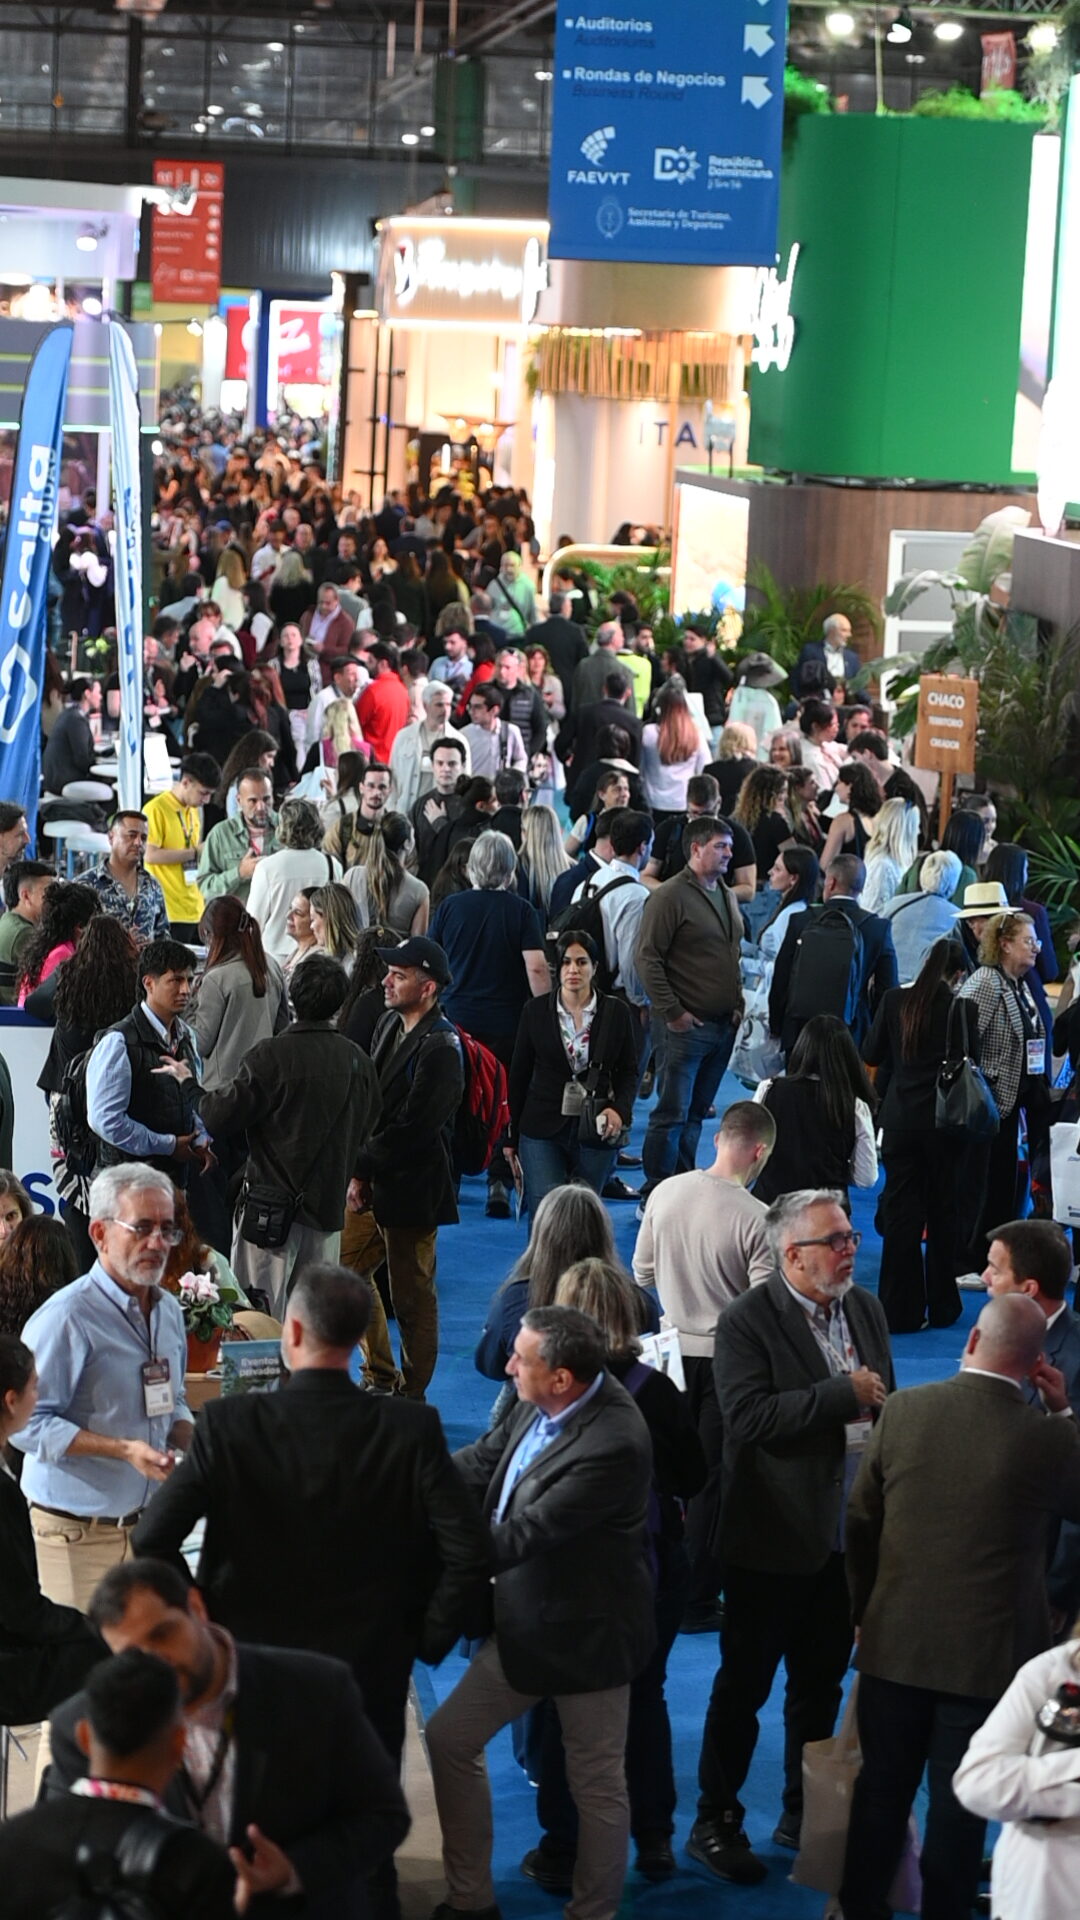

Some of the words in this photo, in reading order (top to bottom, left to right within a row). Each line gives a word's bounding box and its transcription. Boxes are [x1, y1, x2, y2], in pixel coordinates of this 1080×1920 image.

[575, 16, 653, 32] Auditorios
[573, 66, 631, 82] Rondas
[634, 70, 653, 84] de
[656, 70, 726, 87] Negocios
[567, 170, 631, 185] FAEVYT
[708, 166, 773, 179] Dominicana
[677, 209, 688, 219] de
[627, 217, 672, 228] Ambiente
[673, 220, 680, 230] y
[681, 219, 724, 231] Deportes
[8, 444, 50, 628] salta
[928, 692, 965, 709] CHACO
[930, 738, 960, 750] CREADOR
[241, 1357, 280, 1367] Eventos
[240, 1366, 281, 1377] privados
